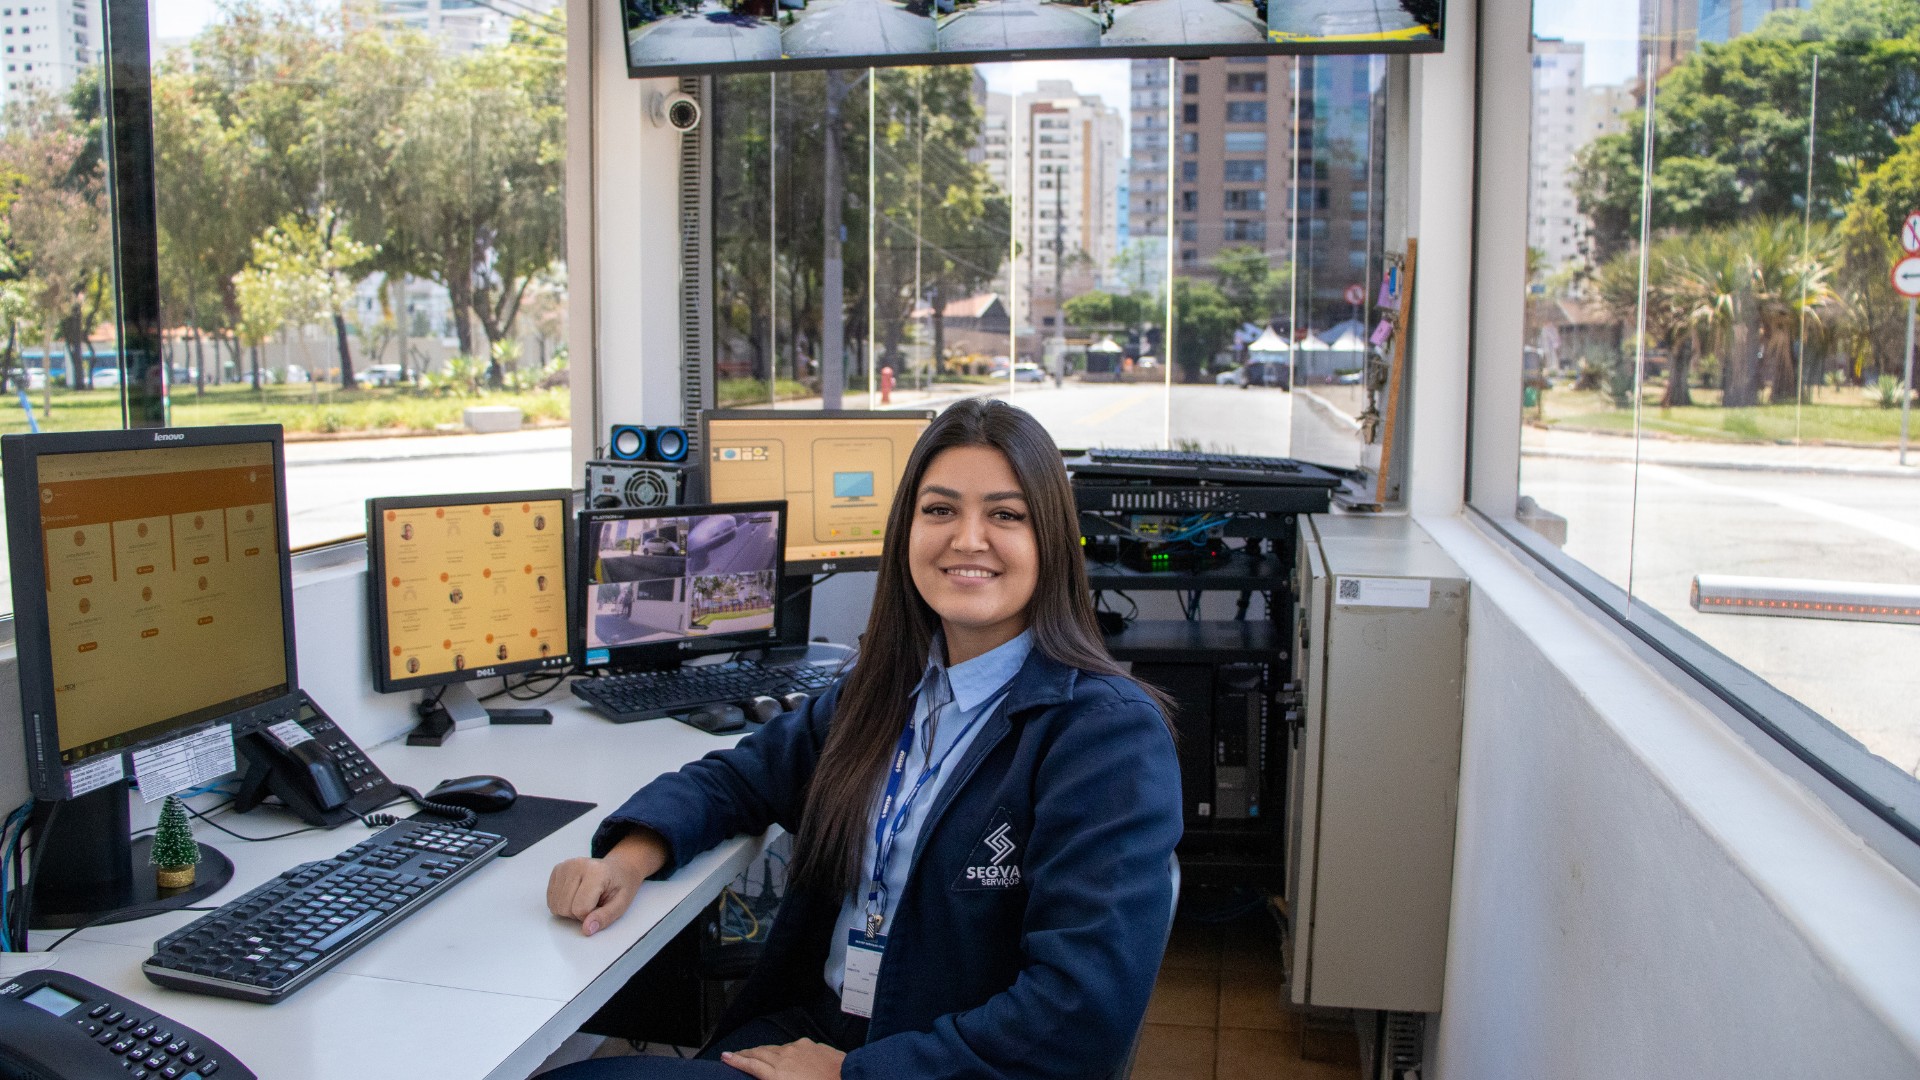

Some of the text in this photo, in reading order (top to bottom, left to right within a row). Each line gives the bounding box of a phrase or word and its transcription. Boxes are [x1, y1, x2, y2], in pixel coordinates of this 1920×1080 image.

[154, 432, 185, 441] lenovo
[476, 667, 496, 678] DELL
[981, 877, 1020, 888] SERVIÇOS
[149, 1057, 160, 1065] 8
